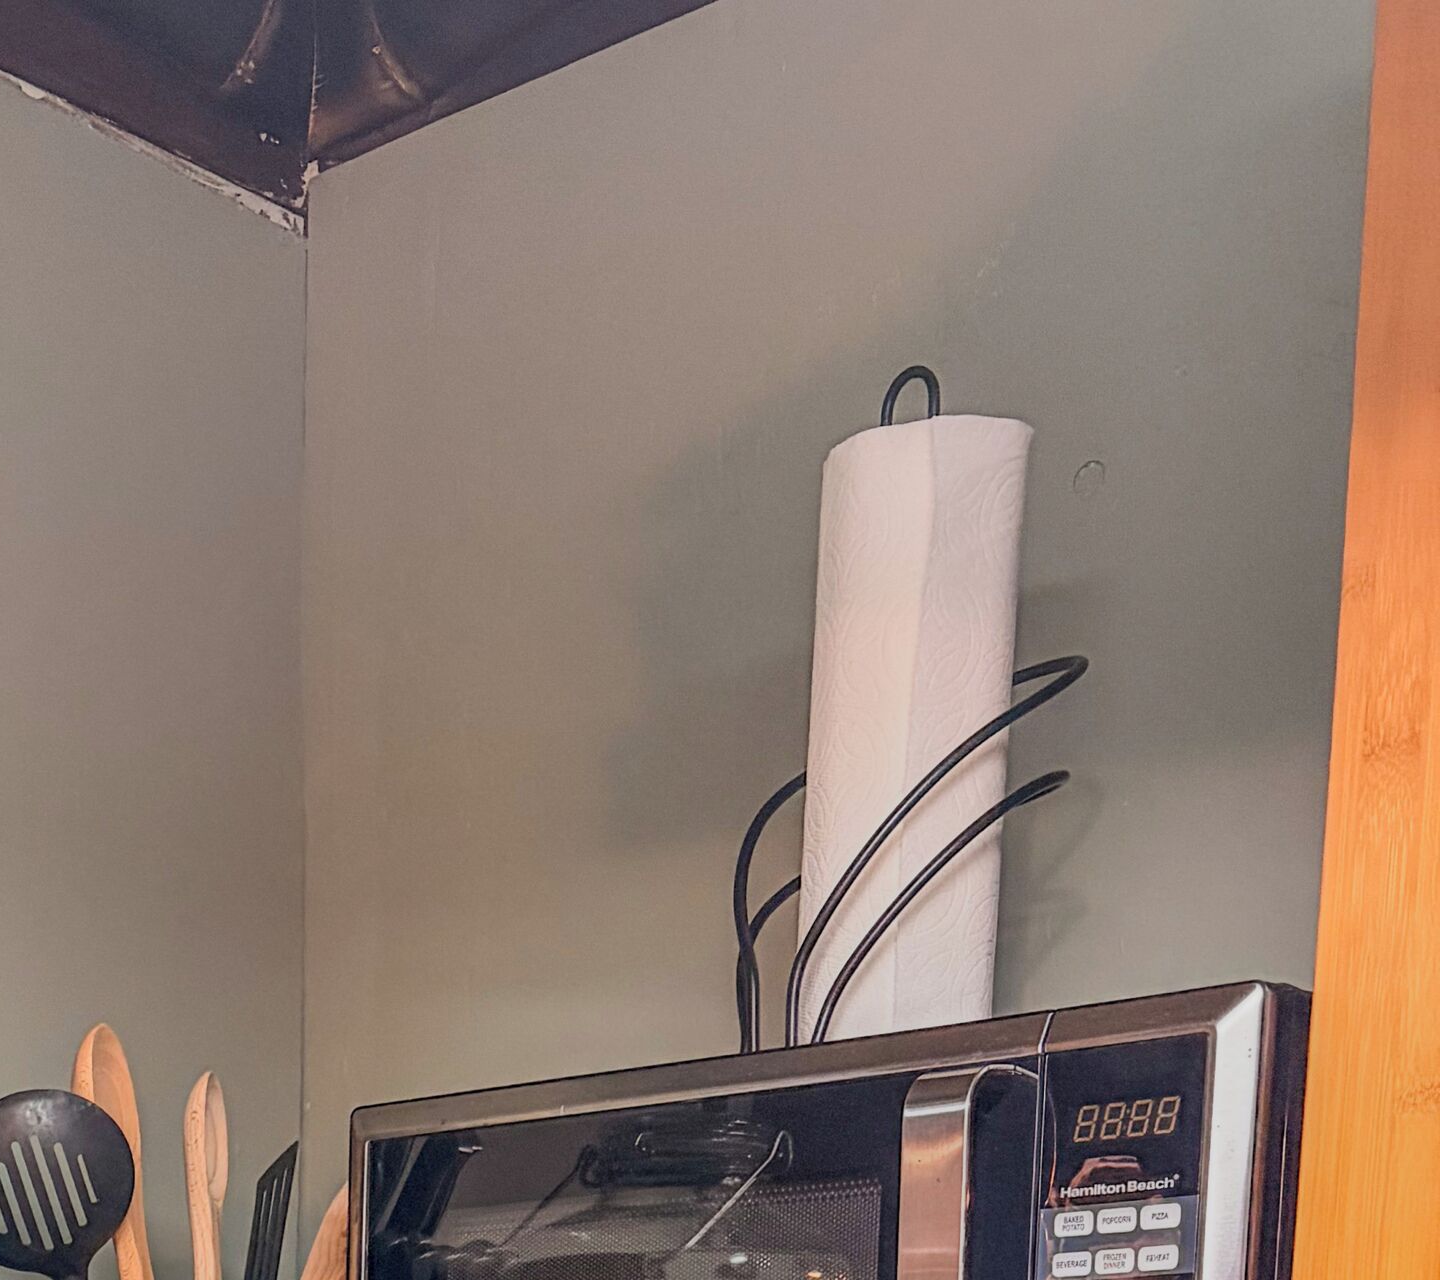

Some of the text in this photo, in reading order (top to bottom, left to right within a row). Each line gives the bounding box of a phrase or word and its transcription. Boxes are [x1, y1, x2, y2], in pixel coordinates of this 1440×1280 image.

[1060, 1182, 1126, 1199] Hamilton
[1102, 1215, 1131, 1225] POPCORN
[1055, 1259, 1088, 1269] BEVERAGE
